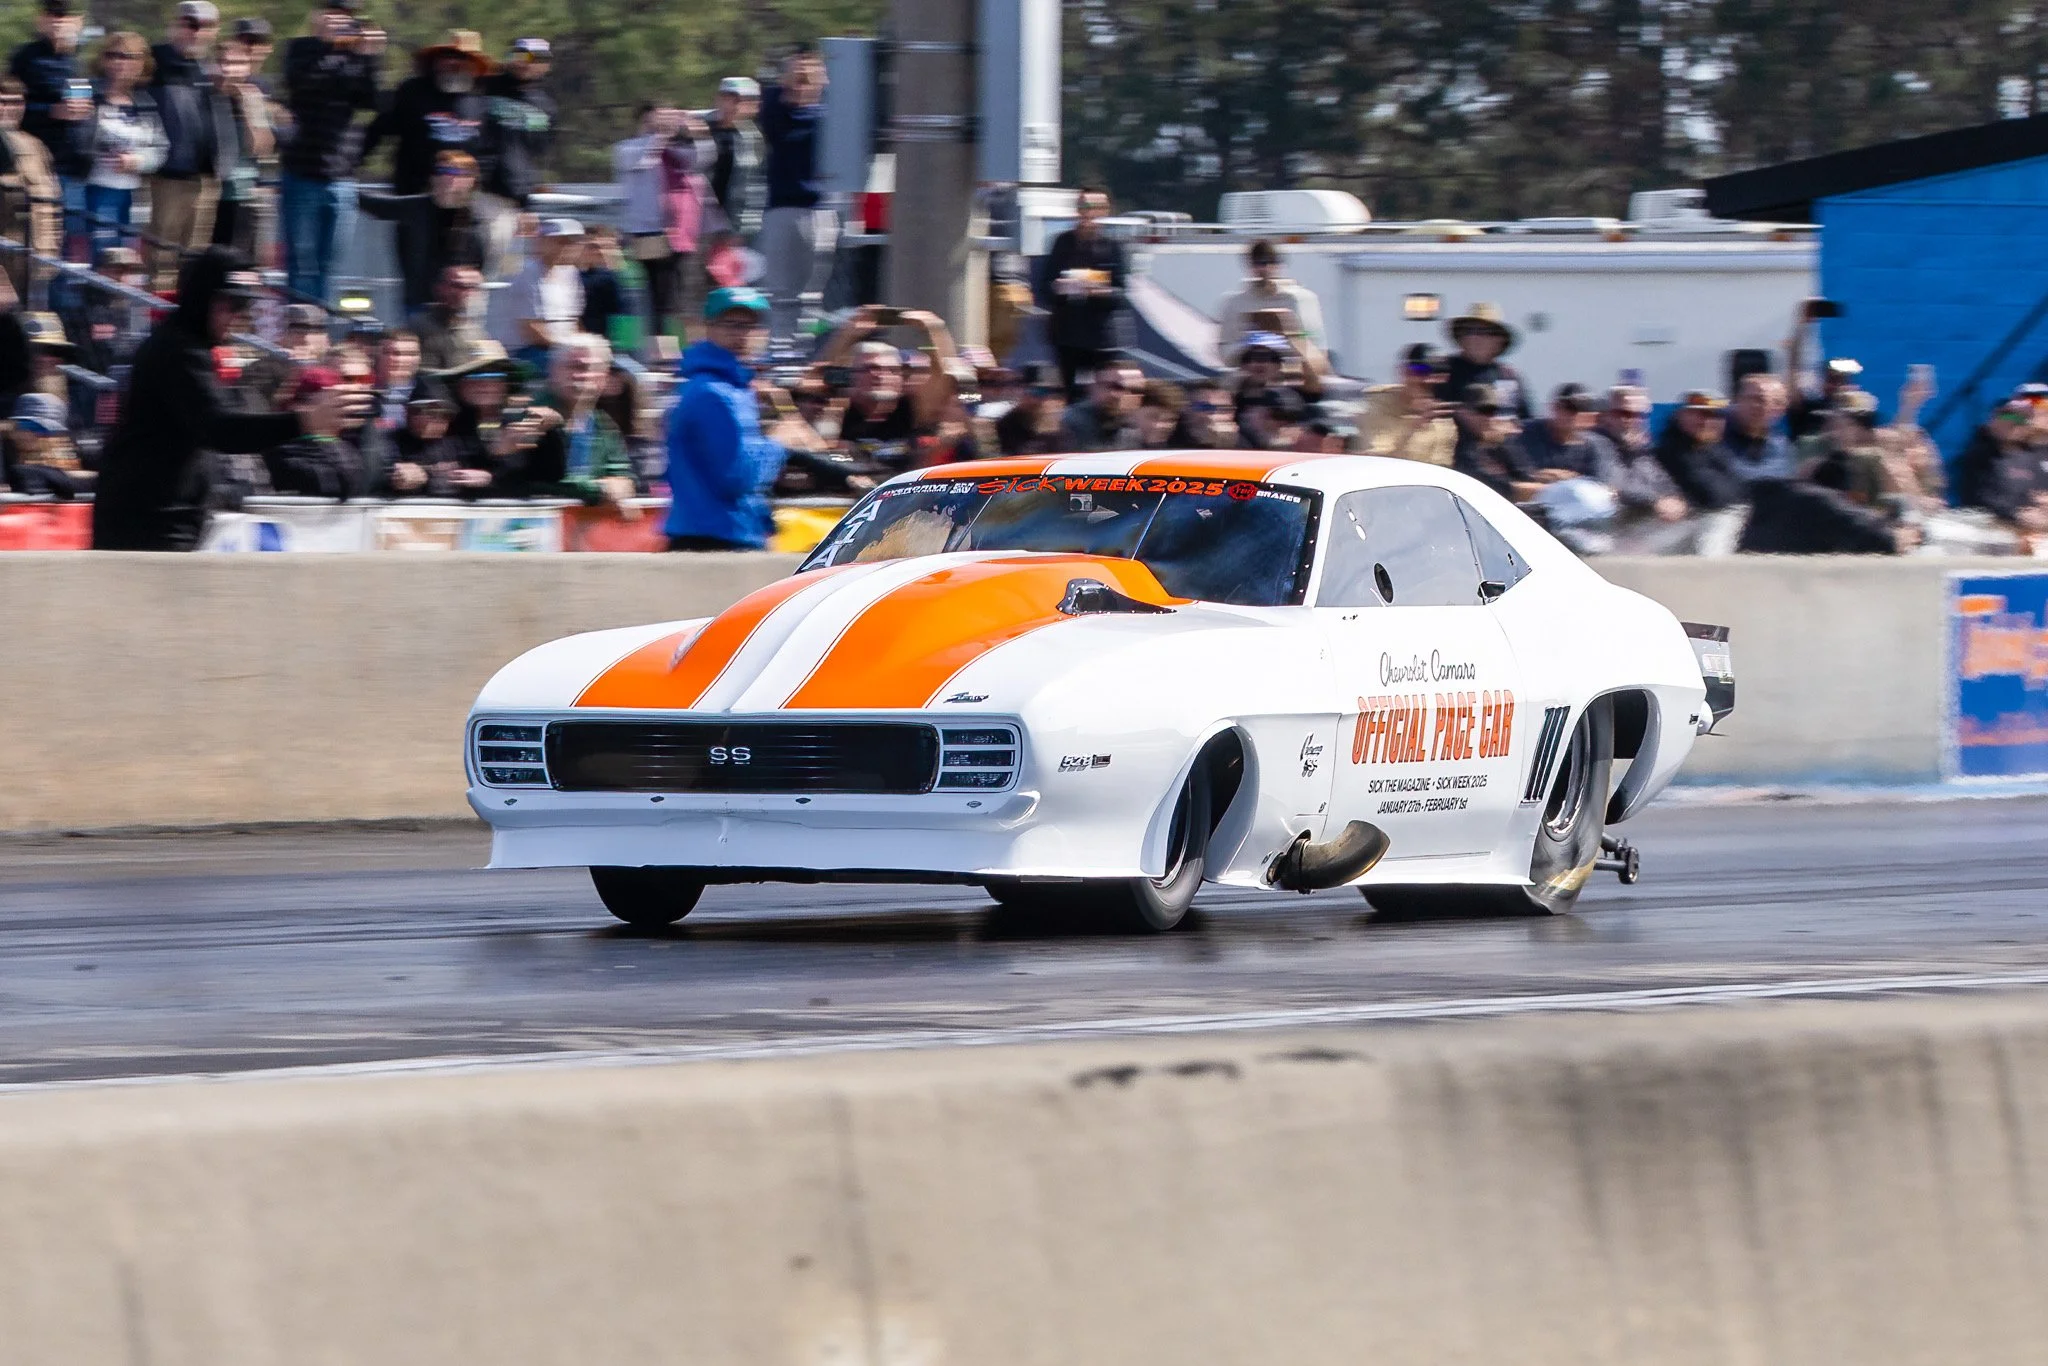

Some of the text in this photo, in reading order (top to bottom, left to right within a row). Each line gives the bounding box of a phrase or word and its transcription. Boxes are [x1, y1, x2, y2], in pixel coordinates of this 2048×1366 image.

[978, 476, 1225, 496] SICK WEEK 2025
[1380, 649, 1475, 687] Chevrolet Camaro
[1352, 689, 1514, 764] OFFICIAL PACE CAR
[710, 746, 751, 760] SS
[1368, 780, 1385, 793] SICK
[1385, 779, 1397, 792] THE
[1397, 778, 1431, 791] MAGAZINE
[1436, 777, 1453, 790] SICK
[1453, 776, 1472, 789] WEEK
[1471, 775, 1487, 788] 2025
[1377, 800, 1408, 814] JANUARY
[1423, 797, 1459, 812] FEBRUARY
